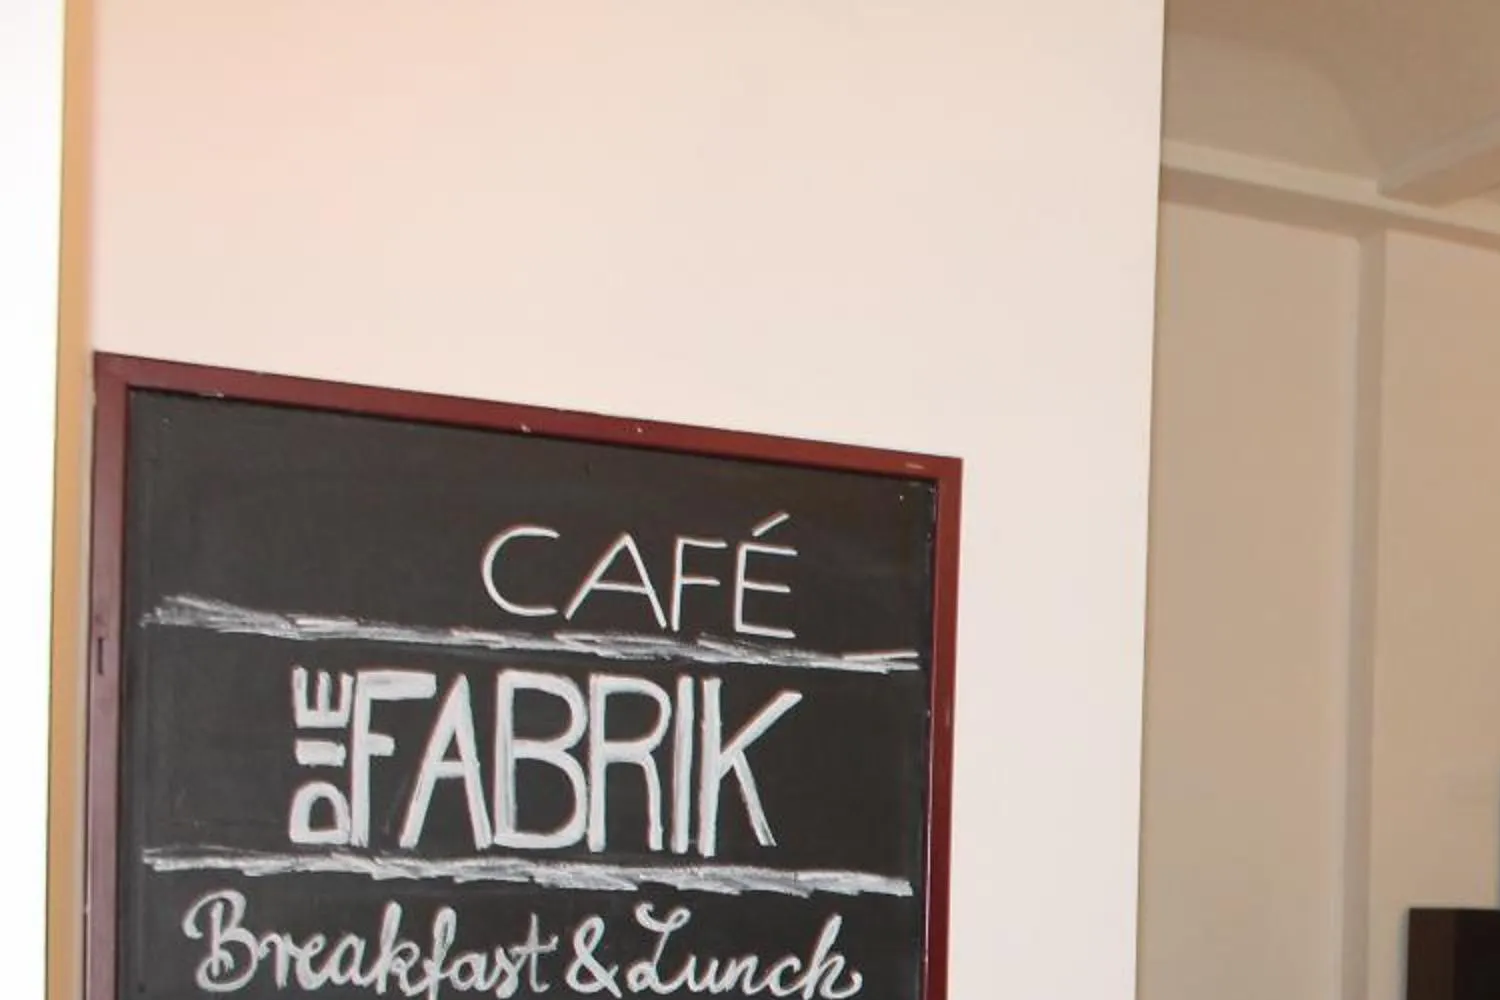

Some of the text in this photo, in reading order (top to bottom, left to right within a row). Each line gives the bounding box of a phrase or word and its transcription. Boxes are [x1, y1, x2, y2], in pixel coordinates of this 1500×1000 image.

[482, 512, 799, 639] CAFÉ
[289, 666, 803, 858] DIE FABRIK
[565, 905, 623, 998] &
[626, 902, 863, 1000] Lunch
